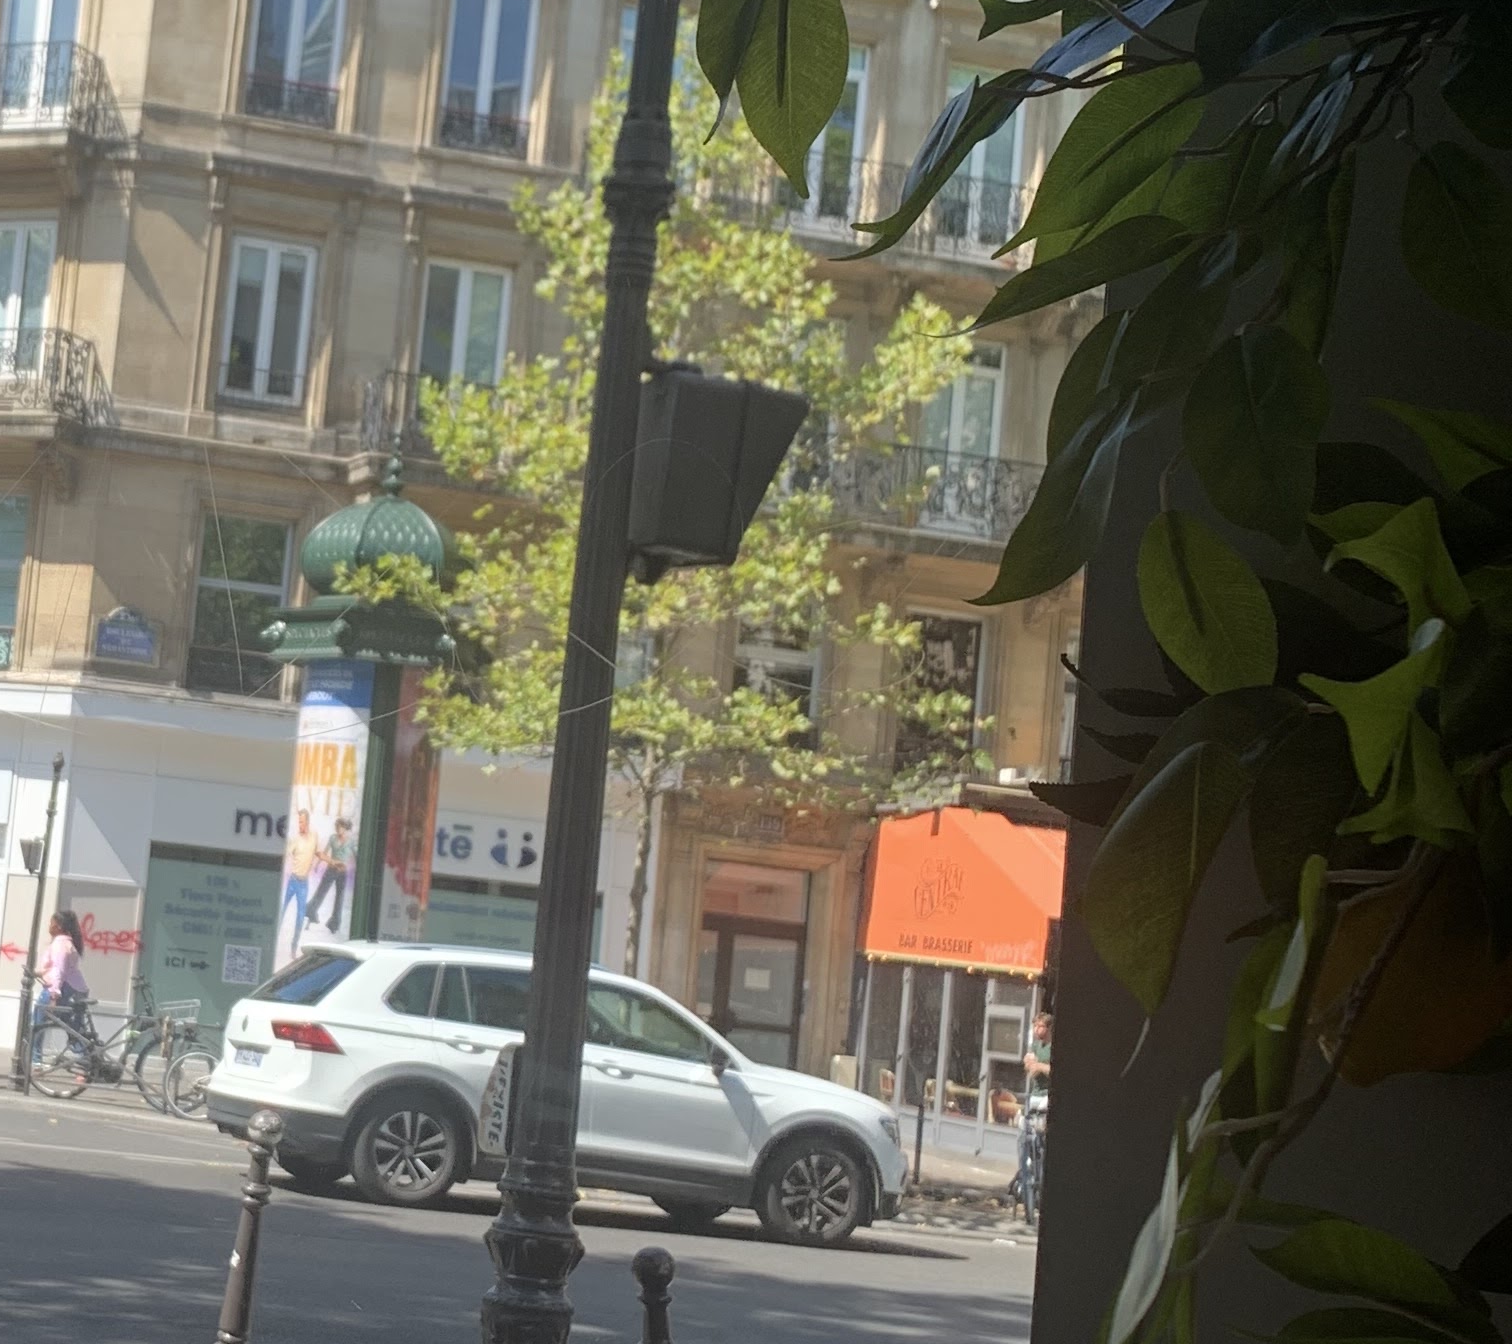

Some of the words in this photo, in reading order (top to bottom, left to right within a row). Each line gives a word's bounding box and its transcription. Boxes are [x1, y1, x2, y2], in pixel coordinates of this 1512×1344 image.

[898, 933, 918, 949] BAR
[922, 935, 973, 954] BRASSERIE
[165, 956, 186, 968] ICI
